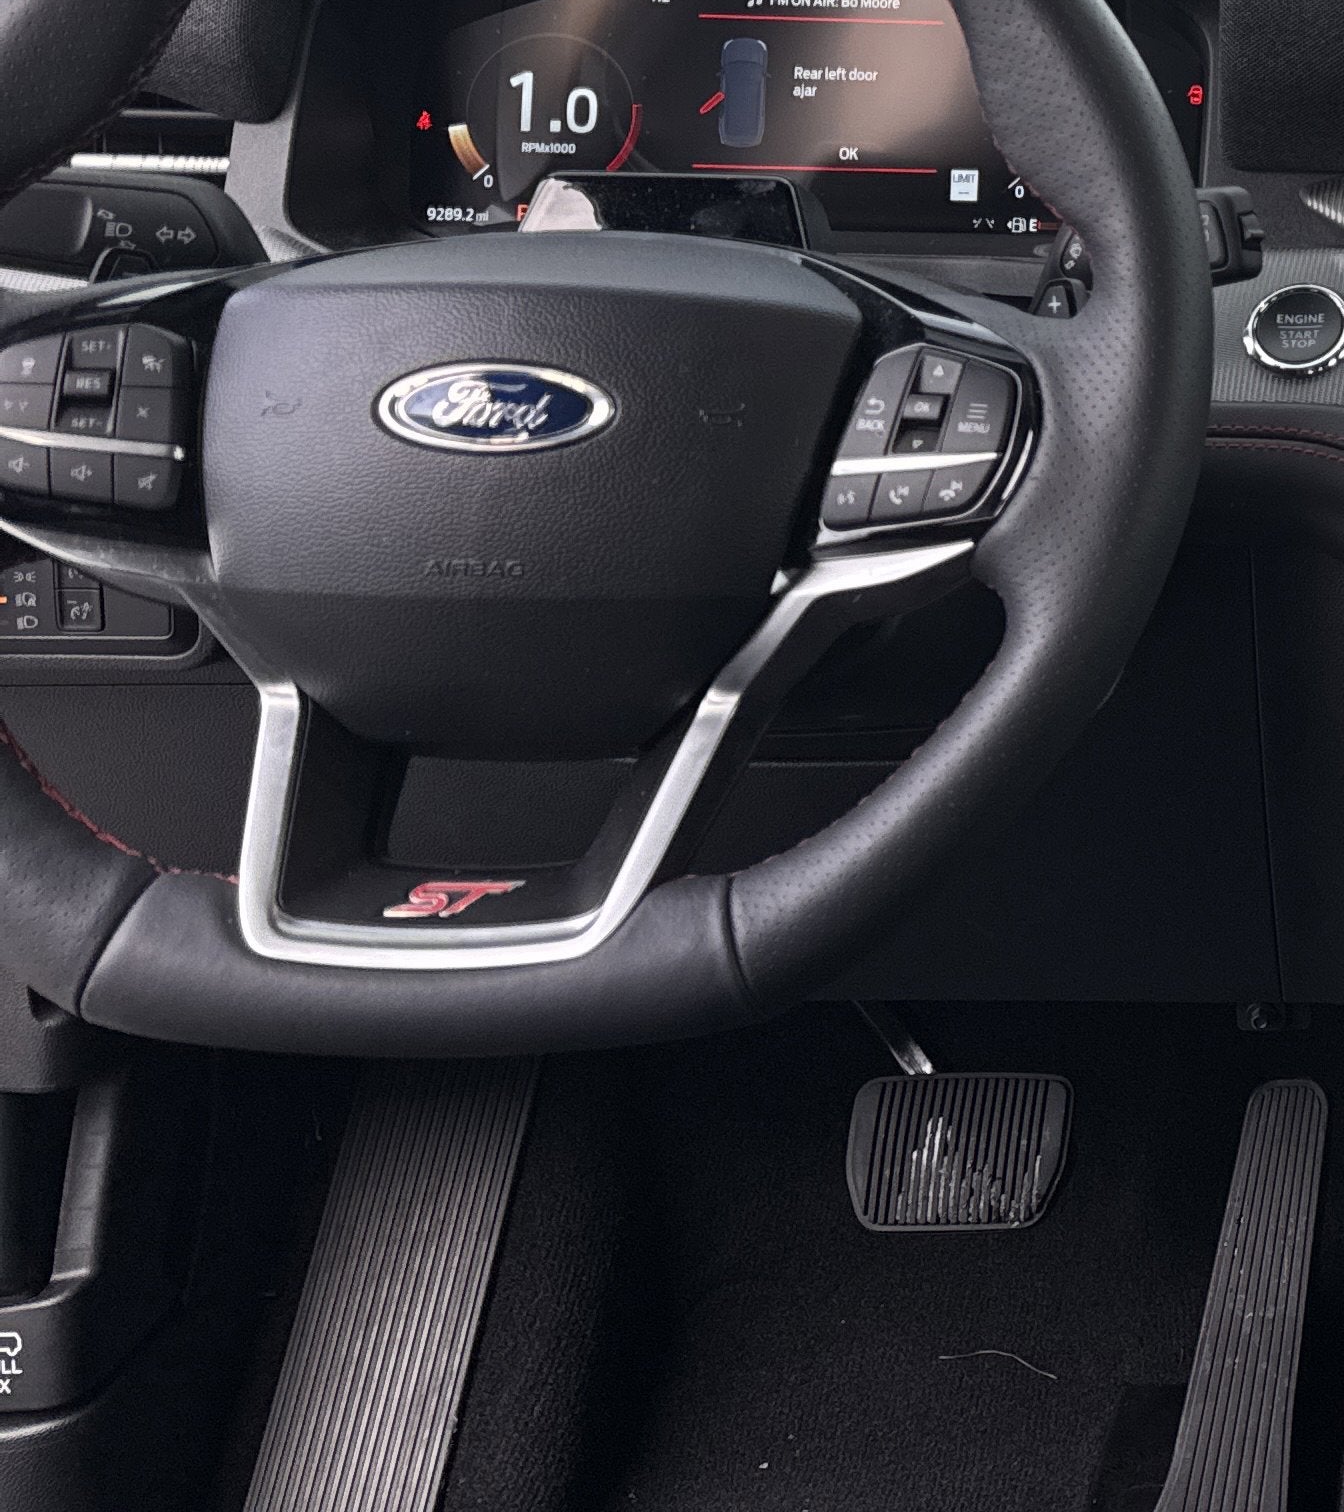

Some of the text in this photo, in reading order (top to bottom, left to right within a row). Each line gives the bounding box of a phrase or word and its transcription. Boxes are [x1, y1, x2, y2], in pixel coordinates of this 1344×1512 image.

[793, 66, 879, 82] Rear left door
[792, 83, 819, 100] ajar
[509, 70, 599, 135] 1.0
[521, 142, 577, 155] RPMx1000
[838, 147, 859, 162] OK
[483, 174, 494, 188] 0
[953, 173, 977, 184] LIMIT
[1014, 185, 1025, 199] 0
[426, 207, 490, 223] 9289.2 mi
[1028, 217, 1038, 232] E
[1276, 313, 1326, 325] ENGINE
[1279, 329, 1320, 340] START
[1281, 339, 1317, 349] STOP
[75, 377, 101, 390] RES
[431, 379, 554, 431] Ford
[913, 401, 931, 414] OK
[855, 418, 886, 433] BACK
[957, 420, 991, 434] MENU
[425, 559, 526, 579] AIRBAG
[382, 879, 527, 919] ST
